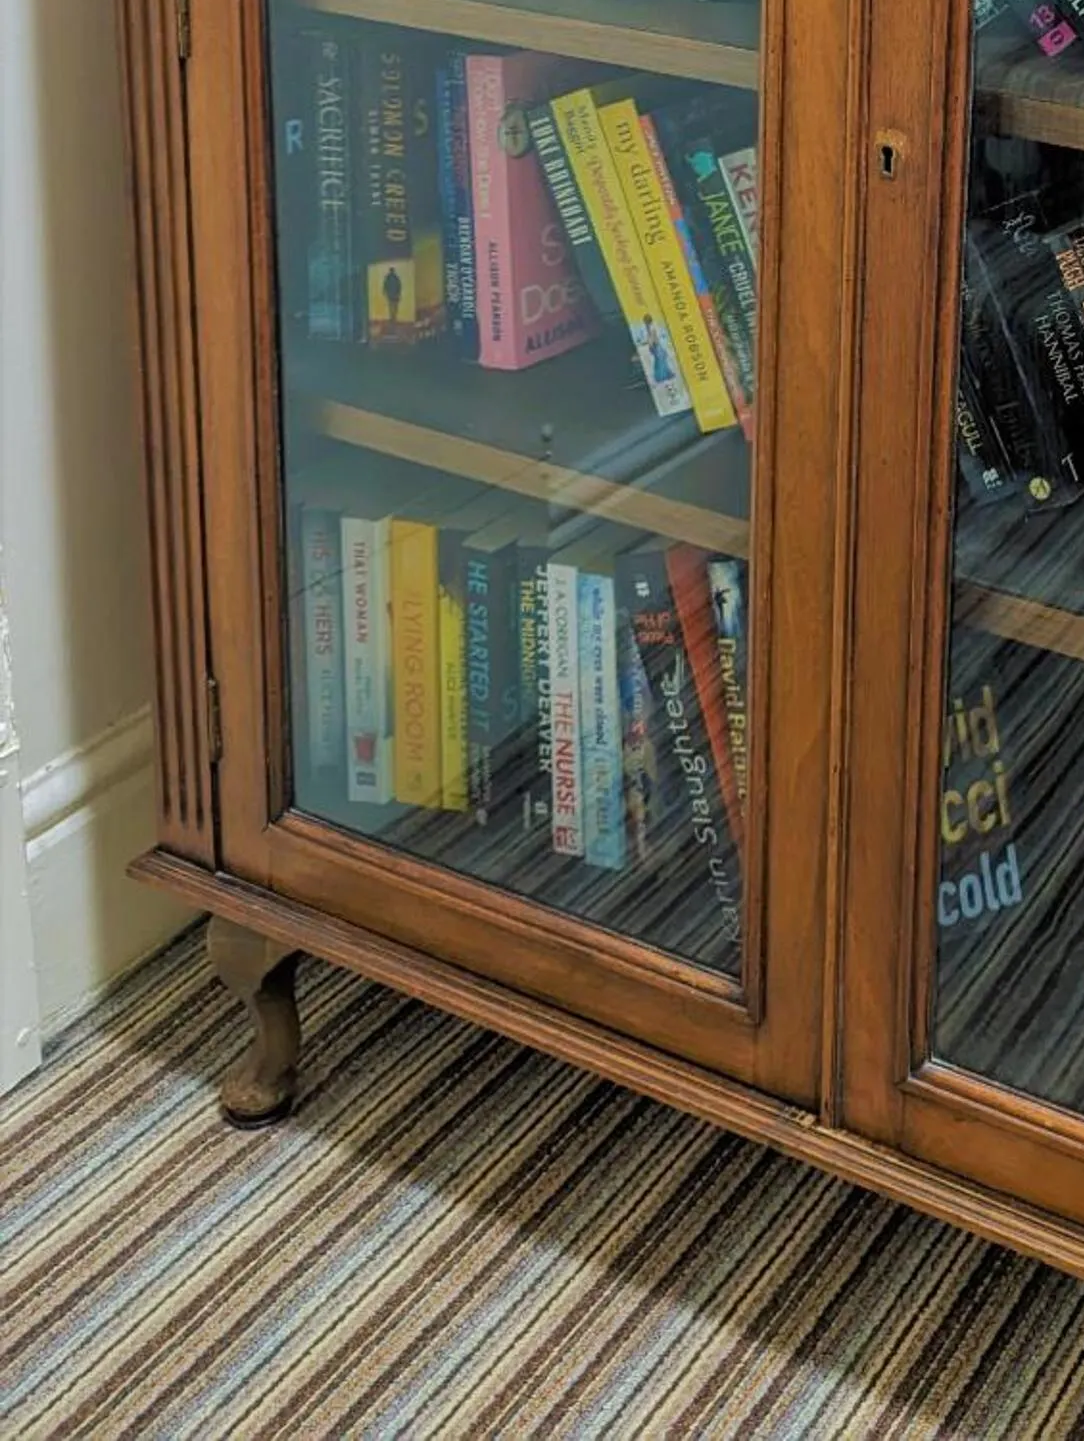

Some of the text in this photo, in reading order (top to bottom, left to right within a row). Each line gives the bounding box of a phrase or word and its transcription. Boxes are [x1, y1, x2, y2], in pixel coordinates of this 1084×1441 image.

[379, 51, 408, 244] SOLOMON CREED
[615, 119, 635, 157] my
[630, 161, 668, 247] darling
[660, 259, 710, 383] AMANDA ROBSON
[1033, 314, 1079, 405] HANNIBAL
[1045, 290, 1084, 361] THOMAS
[353, 585, 369, 645] WOMAN
[466, 560, 492, 707] HE STARTED
[401, 598, 427, 765] LYING ROOM
[553, 690, 576, 817] THE NURSE
[660, 648, 742, 943] Karin Slaughter
[936, 843, 1024, 927] cold
